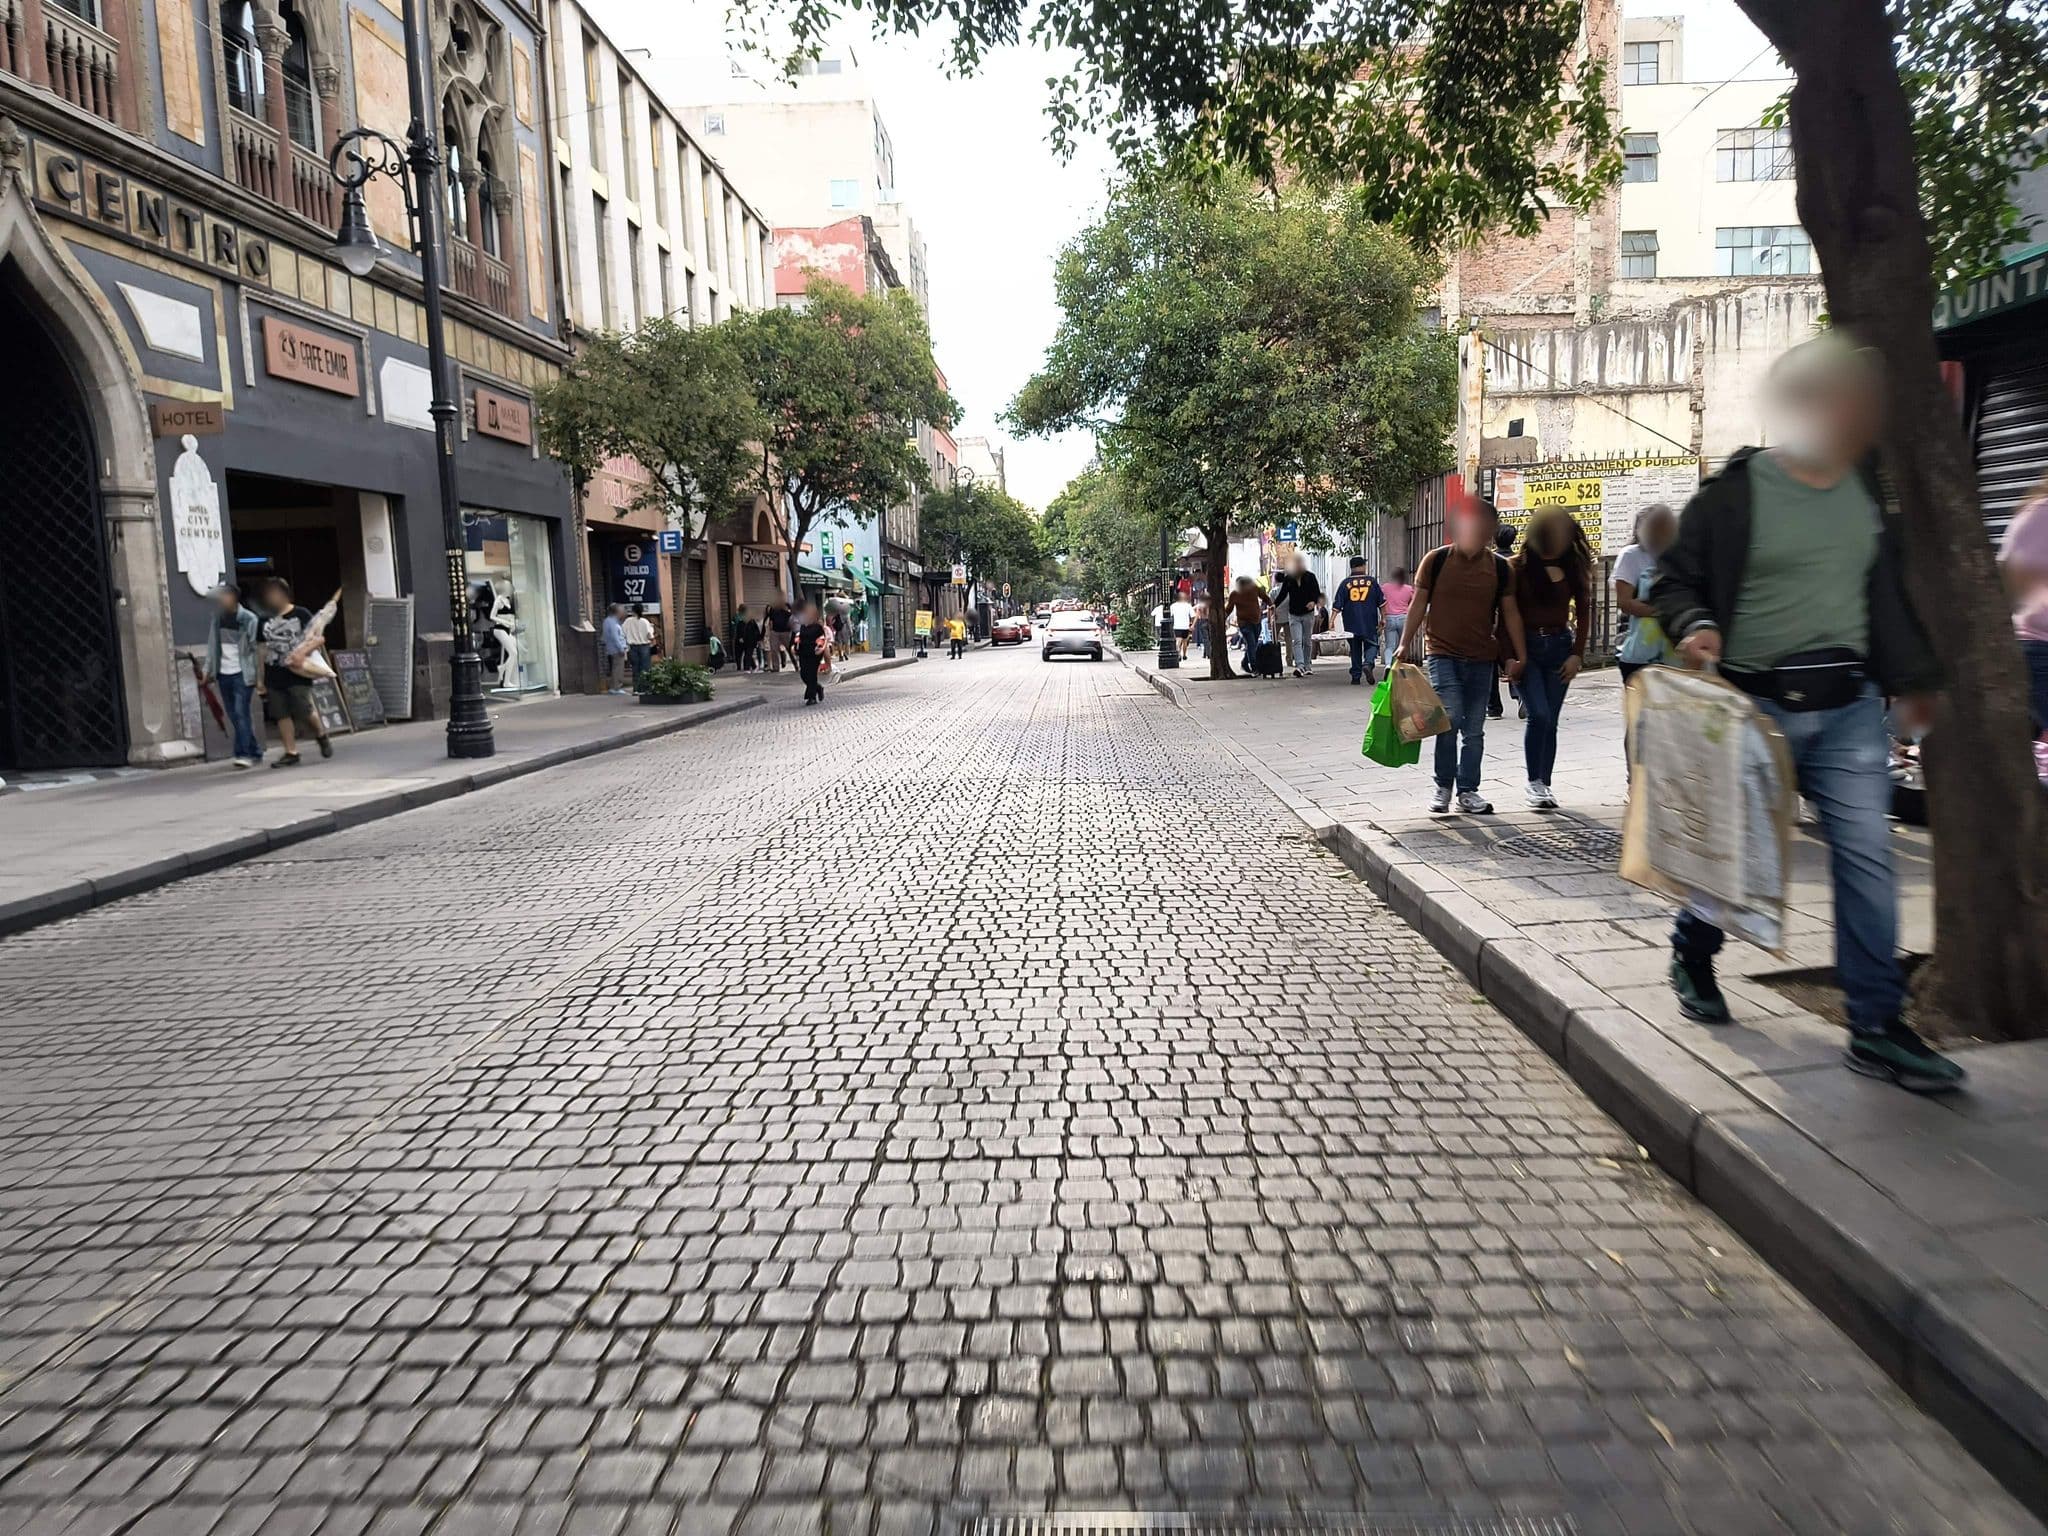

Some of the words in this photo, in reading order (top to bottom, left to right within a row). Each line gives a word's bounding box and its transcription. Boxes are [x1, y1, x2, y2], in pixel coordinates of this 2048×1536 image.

[47, 155, 270, 277] CENTRO
[1931, 257, 2048, 331] QUINT
[324, 348, 350, 381] EMIR
[162, 411, 214, 425] HOTEL
[1523, 459, 1642, 476] ESTACIONAMIENTO
[1571, 471, 1582, 479] DE
[1528, 481, 1571, 493] TARIFA
[1577, 482, 1601, 501] $28
[1533, 495, 1567, 507] AUTO
[188, 515, 209, 526] CITY
[1497, 509, 1532, 518] ARIFA
[663, 533, 677, 550] E
[628, 547, 638, 560] E
[824, 558, 834, 569] E
[1350, 587, 1369, 601] 67
